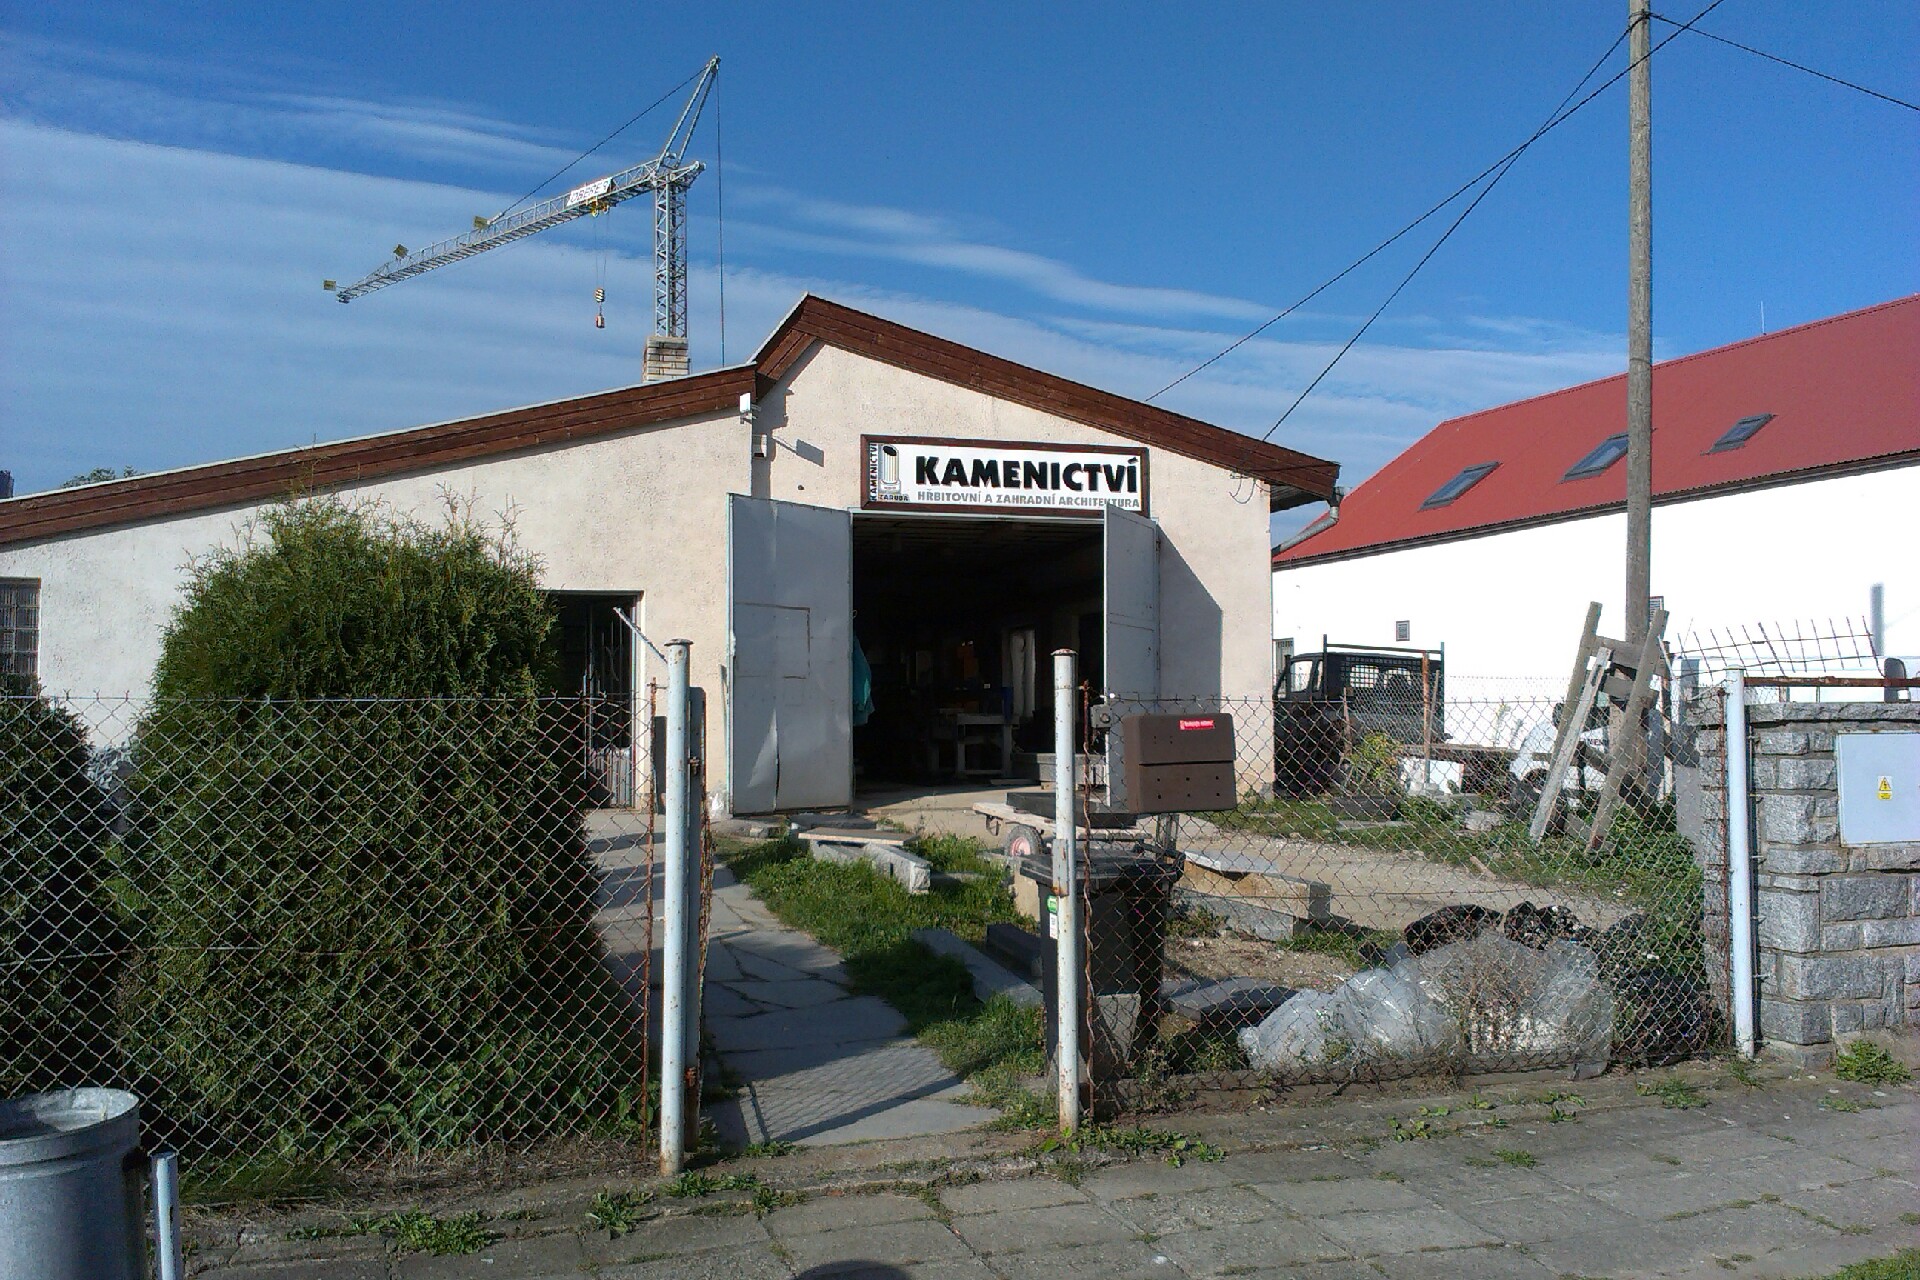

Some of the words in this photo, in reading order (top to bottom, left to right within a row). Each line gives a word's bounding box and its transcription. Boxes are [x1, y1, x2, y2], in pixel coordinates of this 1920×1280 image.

[915, 455, 1139, 493] KAMENICTVÍ
[917, 489, 981, 503] HŘBITOVNÍ
[984, 494, 993, 503] A
[996, 493, 1056, 505] ZAHRADNÍ
